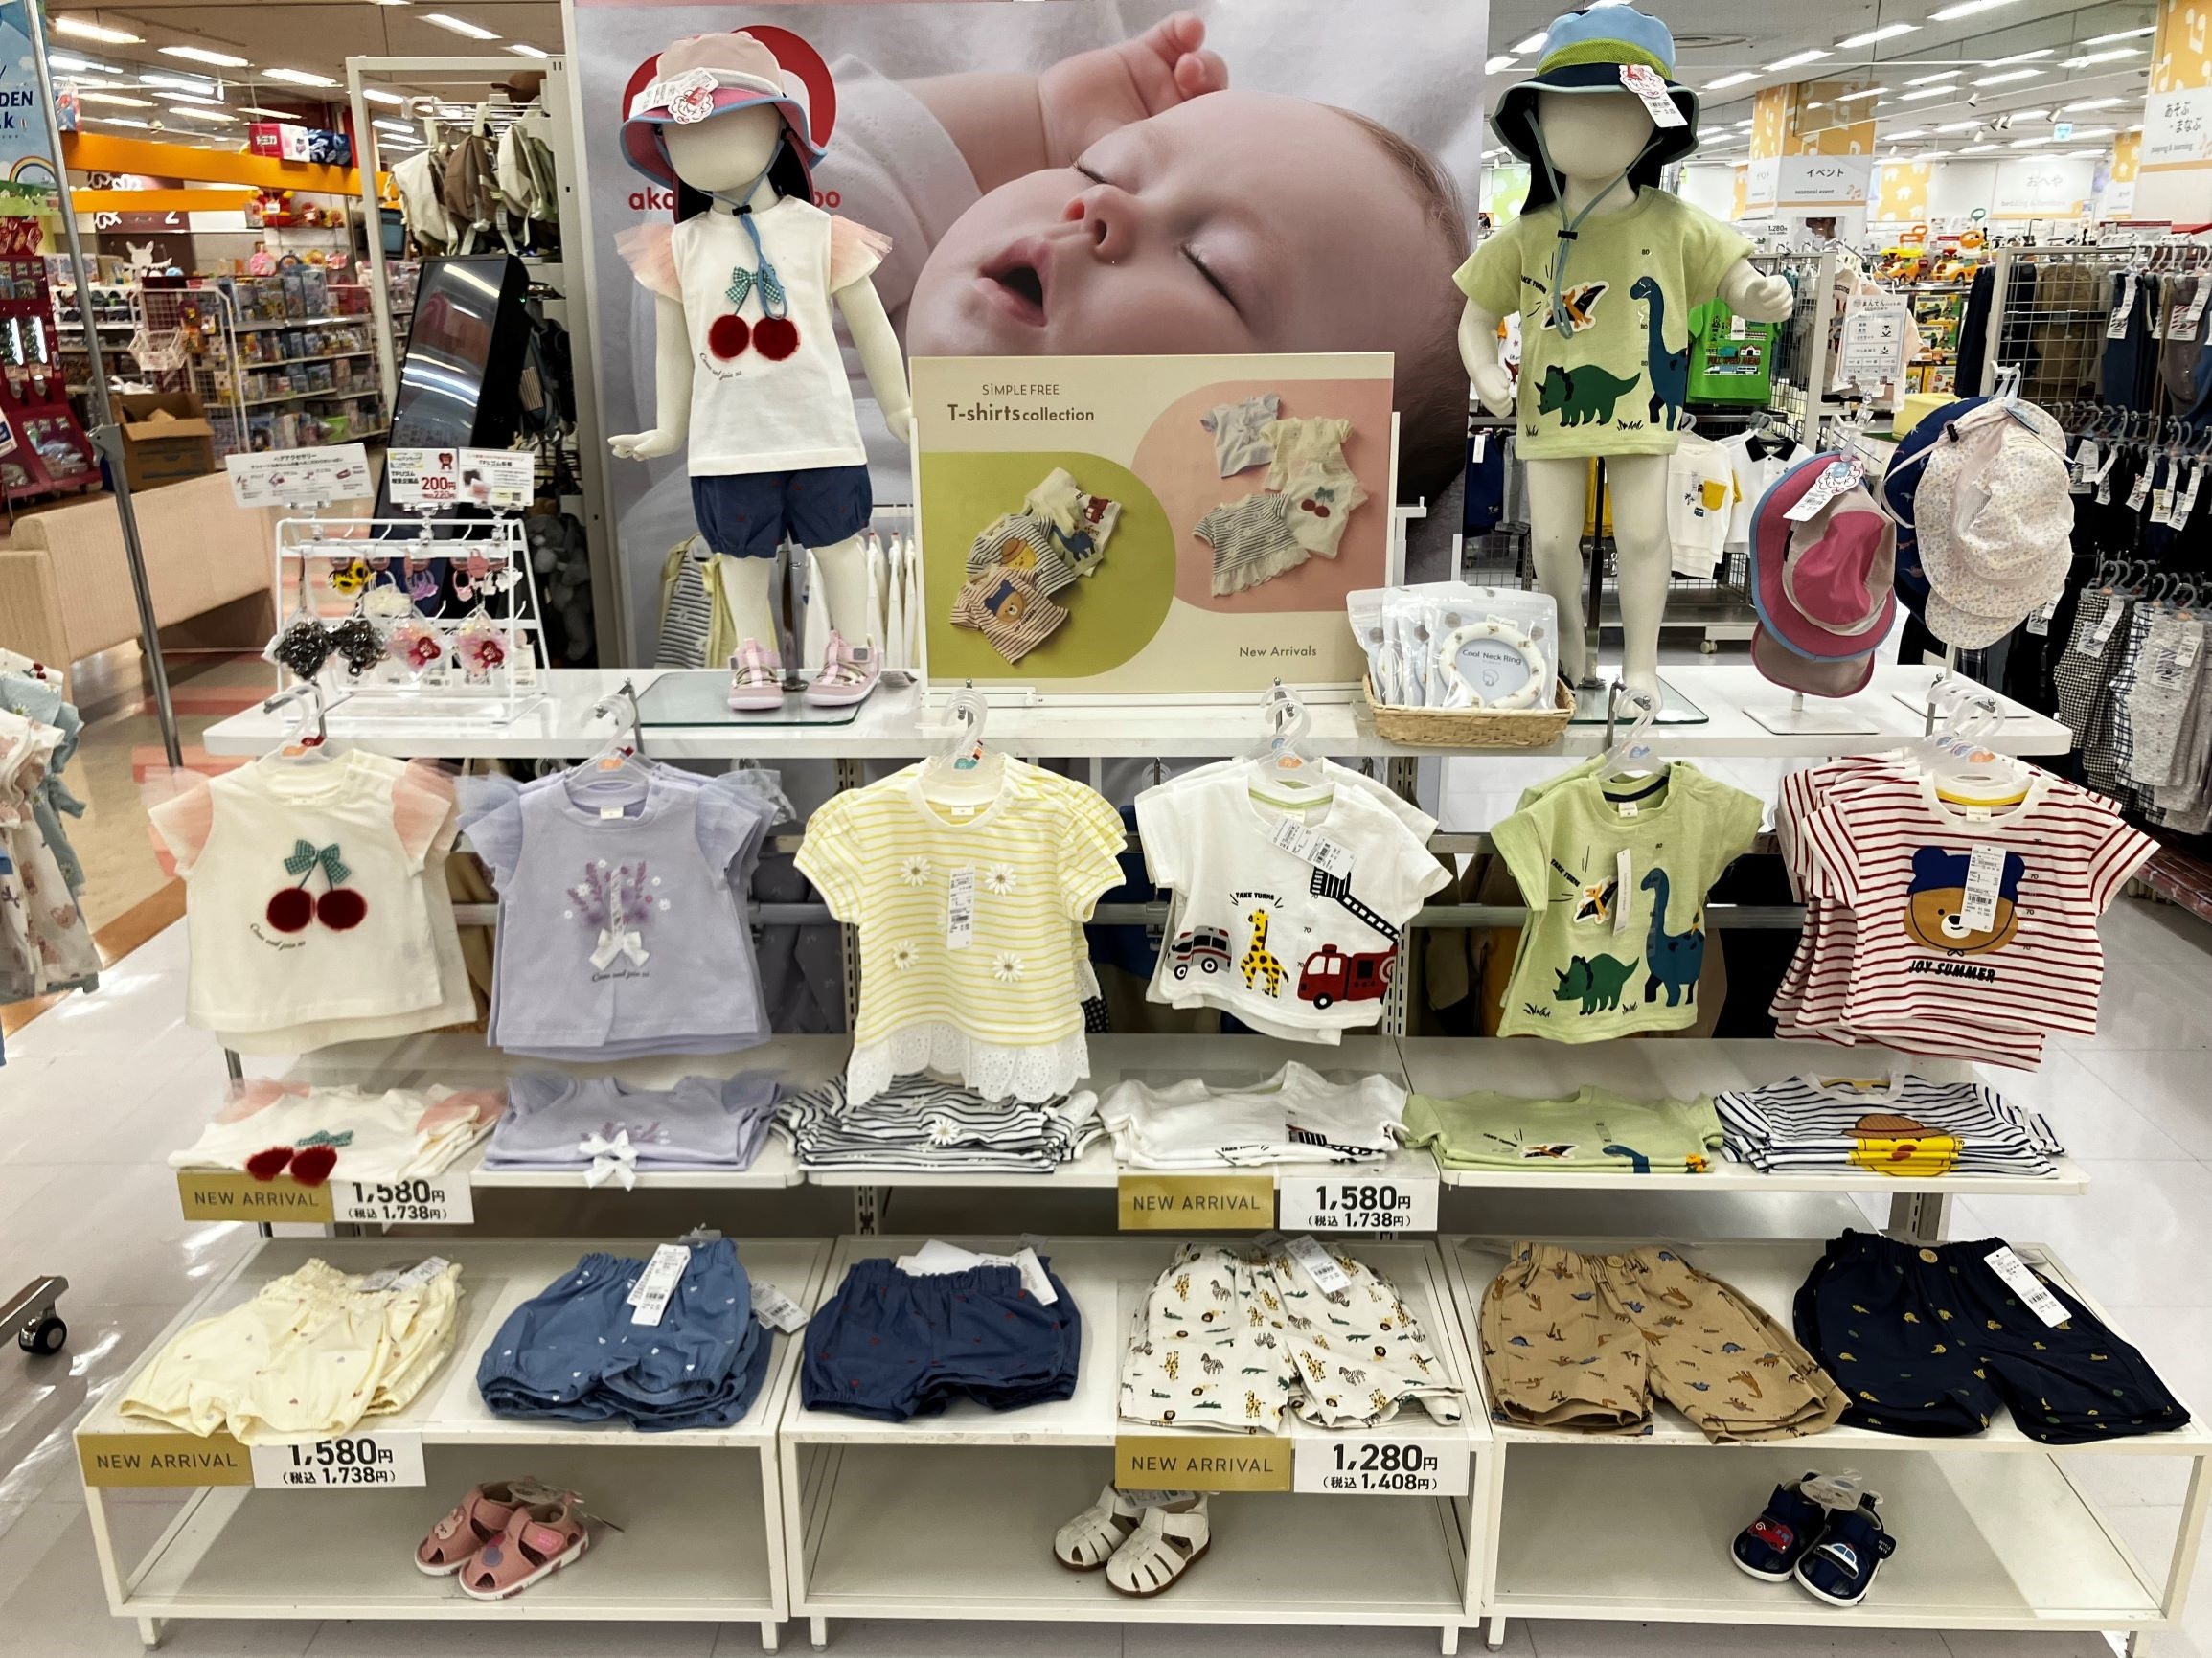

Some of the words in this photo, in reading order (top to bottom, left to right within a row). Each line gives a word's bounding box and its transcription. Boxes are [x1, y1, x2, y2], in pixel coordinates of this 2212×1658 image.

[1807, 168, 1844, 178] イベント
[1030, 384, 1060, 396] FREE
[946, 402, 1021, 421] T-shirts
[1022, 407, 1095, 421] collection
[422, 476, 456, 491] 200円
[1239, 647, 1266, 657] New
[1270, 645, 1317, 657] Arrivals
[1462, 649, 1480, 658] Cool
[1482, 651, 1501, 661] Neck
[1503, 654, 1522, 666] Ring
[1254, 892, 1275, 900] TURNS
[1908, 960, 1933, 974] JOY
[1934, 962, 1995, 984] SUMMER
[194, 1191, 235, 1206] NEW
[242, 1192, 319, 1208] ARRIVAL
[352, 1179, 445, 1204] 1,580円
[1315, 1185, 1412, 1211] 1,580円
[1133, 1195, 1174, 1211] NEW
[1181, 1194, 1261, 1211] ARRIVAL
[287, 1438, 394, 1466] 1,580円
[1332, 1443, 1439, 1472] 1,280円
[97, 1454, 141, 1469] NEW
[150, 1453, 239, 1468] ARRIVAL
[1131, 1455, 1177, 1471] NEW
[1186, 1457, 1274, 1473] ARRIVAL
